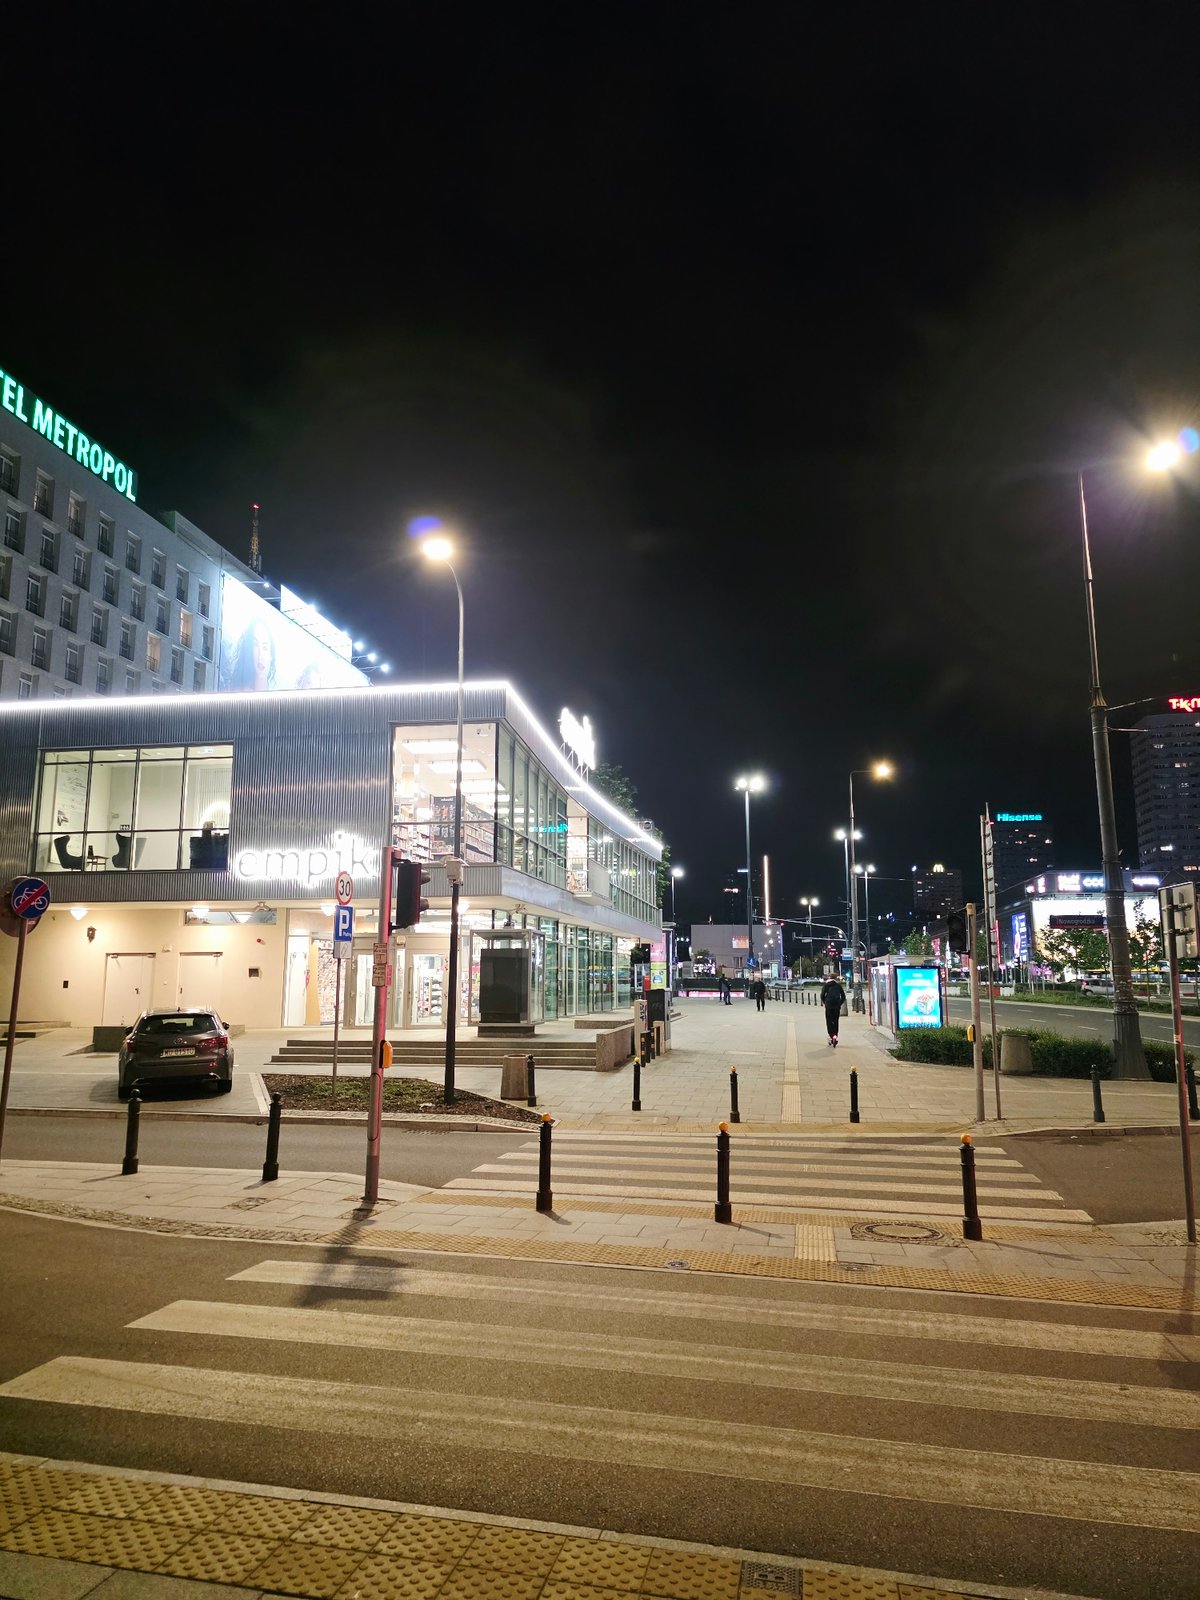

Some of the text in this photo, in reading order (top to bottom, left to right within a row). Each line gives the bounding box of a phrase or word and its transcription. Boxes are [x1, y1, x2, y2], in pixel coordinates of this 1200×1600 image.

[32, 399, 136, 502] METROPOL
[997, 813, 1042, 821] Hisense
[237, 833, 372, 885] empik
[339, 879, 351, 896] 30
[338, 909, 349, 936] P
